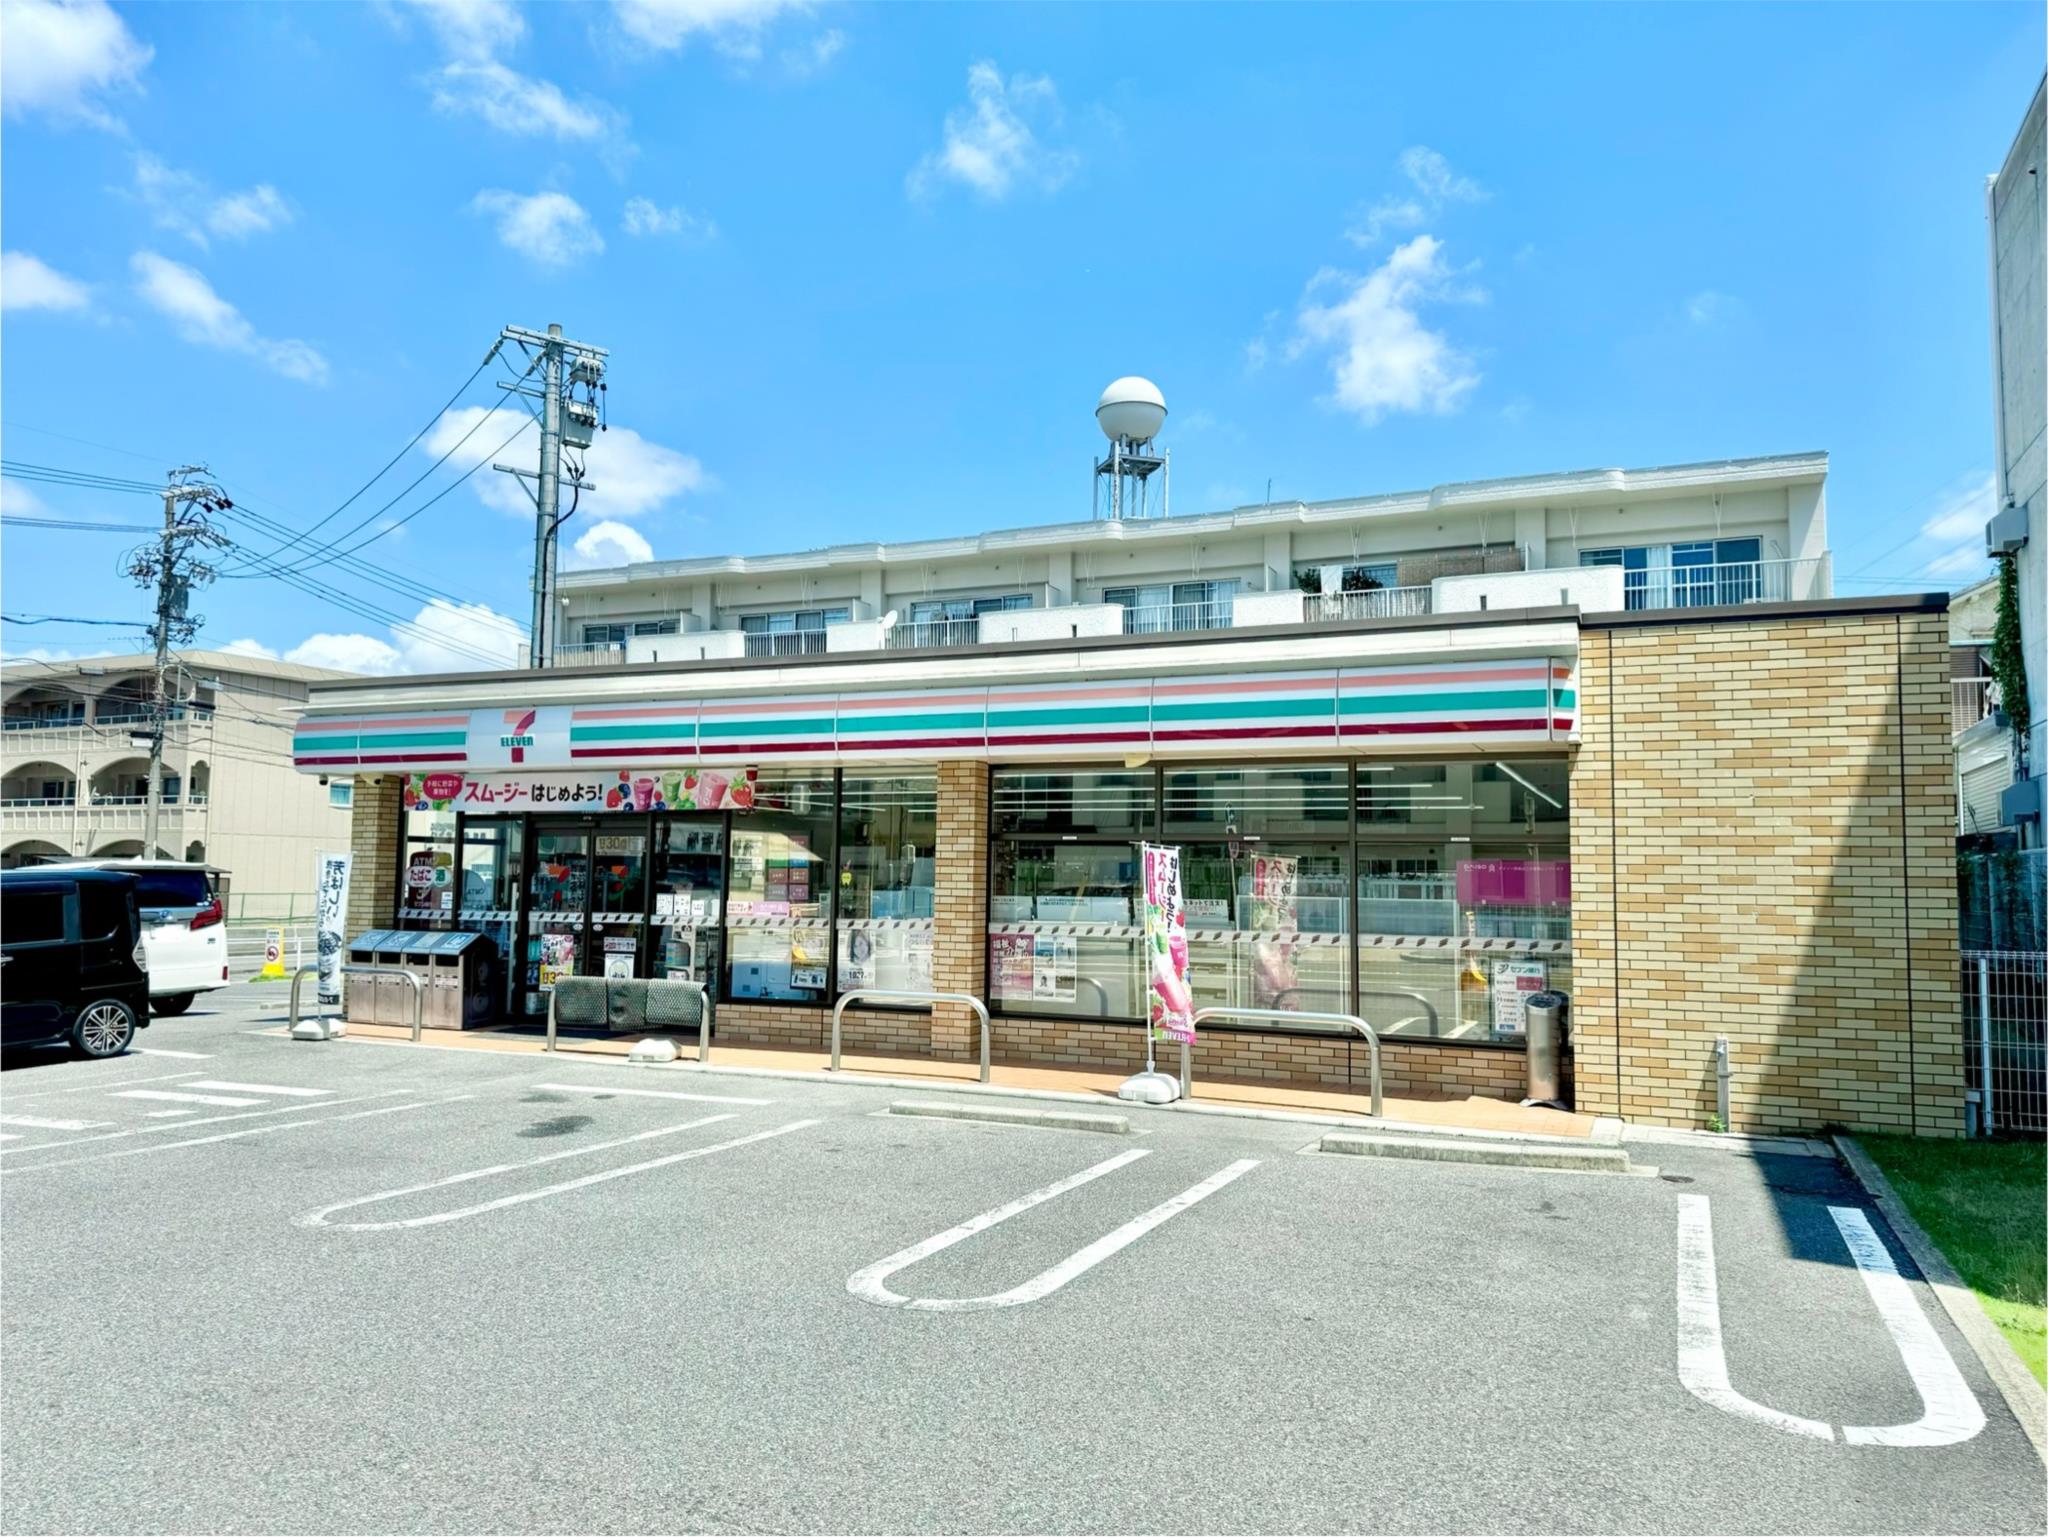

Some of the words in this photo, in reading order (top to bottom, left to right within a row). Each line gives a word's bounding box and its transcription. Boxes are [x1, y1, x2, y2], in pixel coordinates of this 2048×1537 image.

[465, 782, 528, 802] スムージー
[410, 869, 431, 882] たばこ
